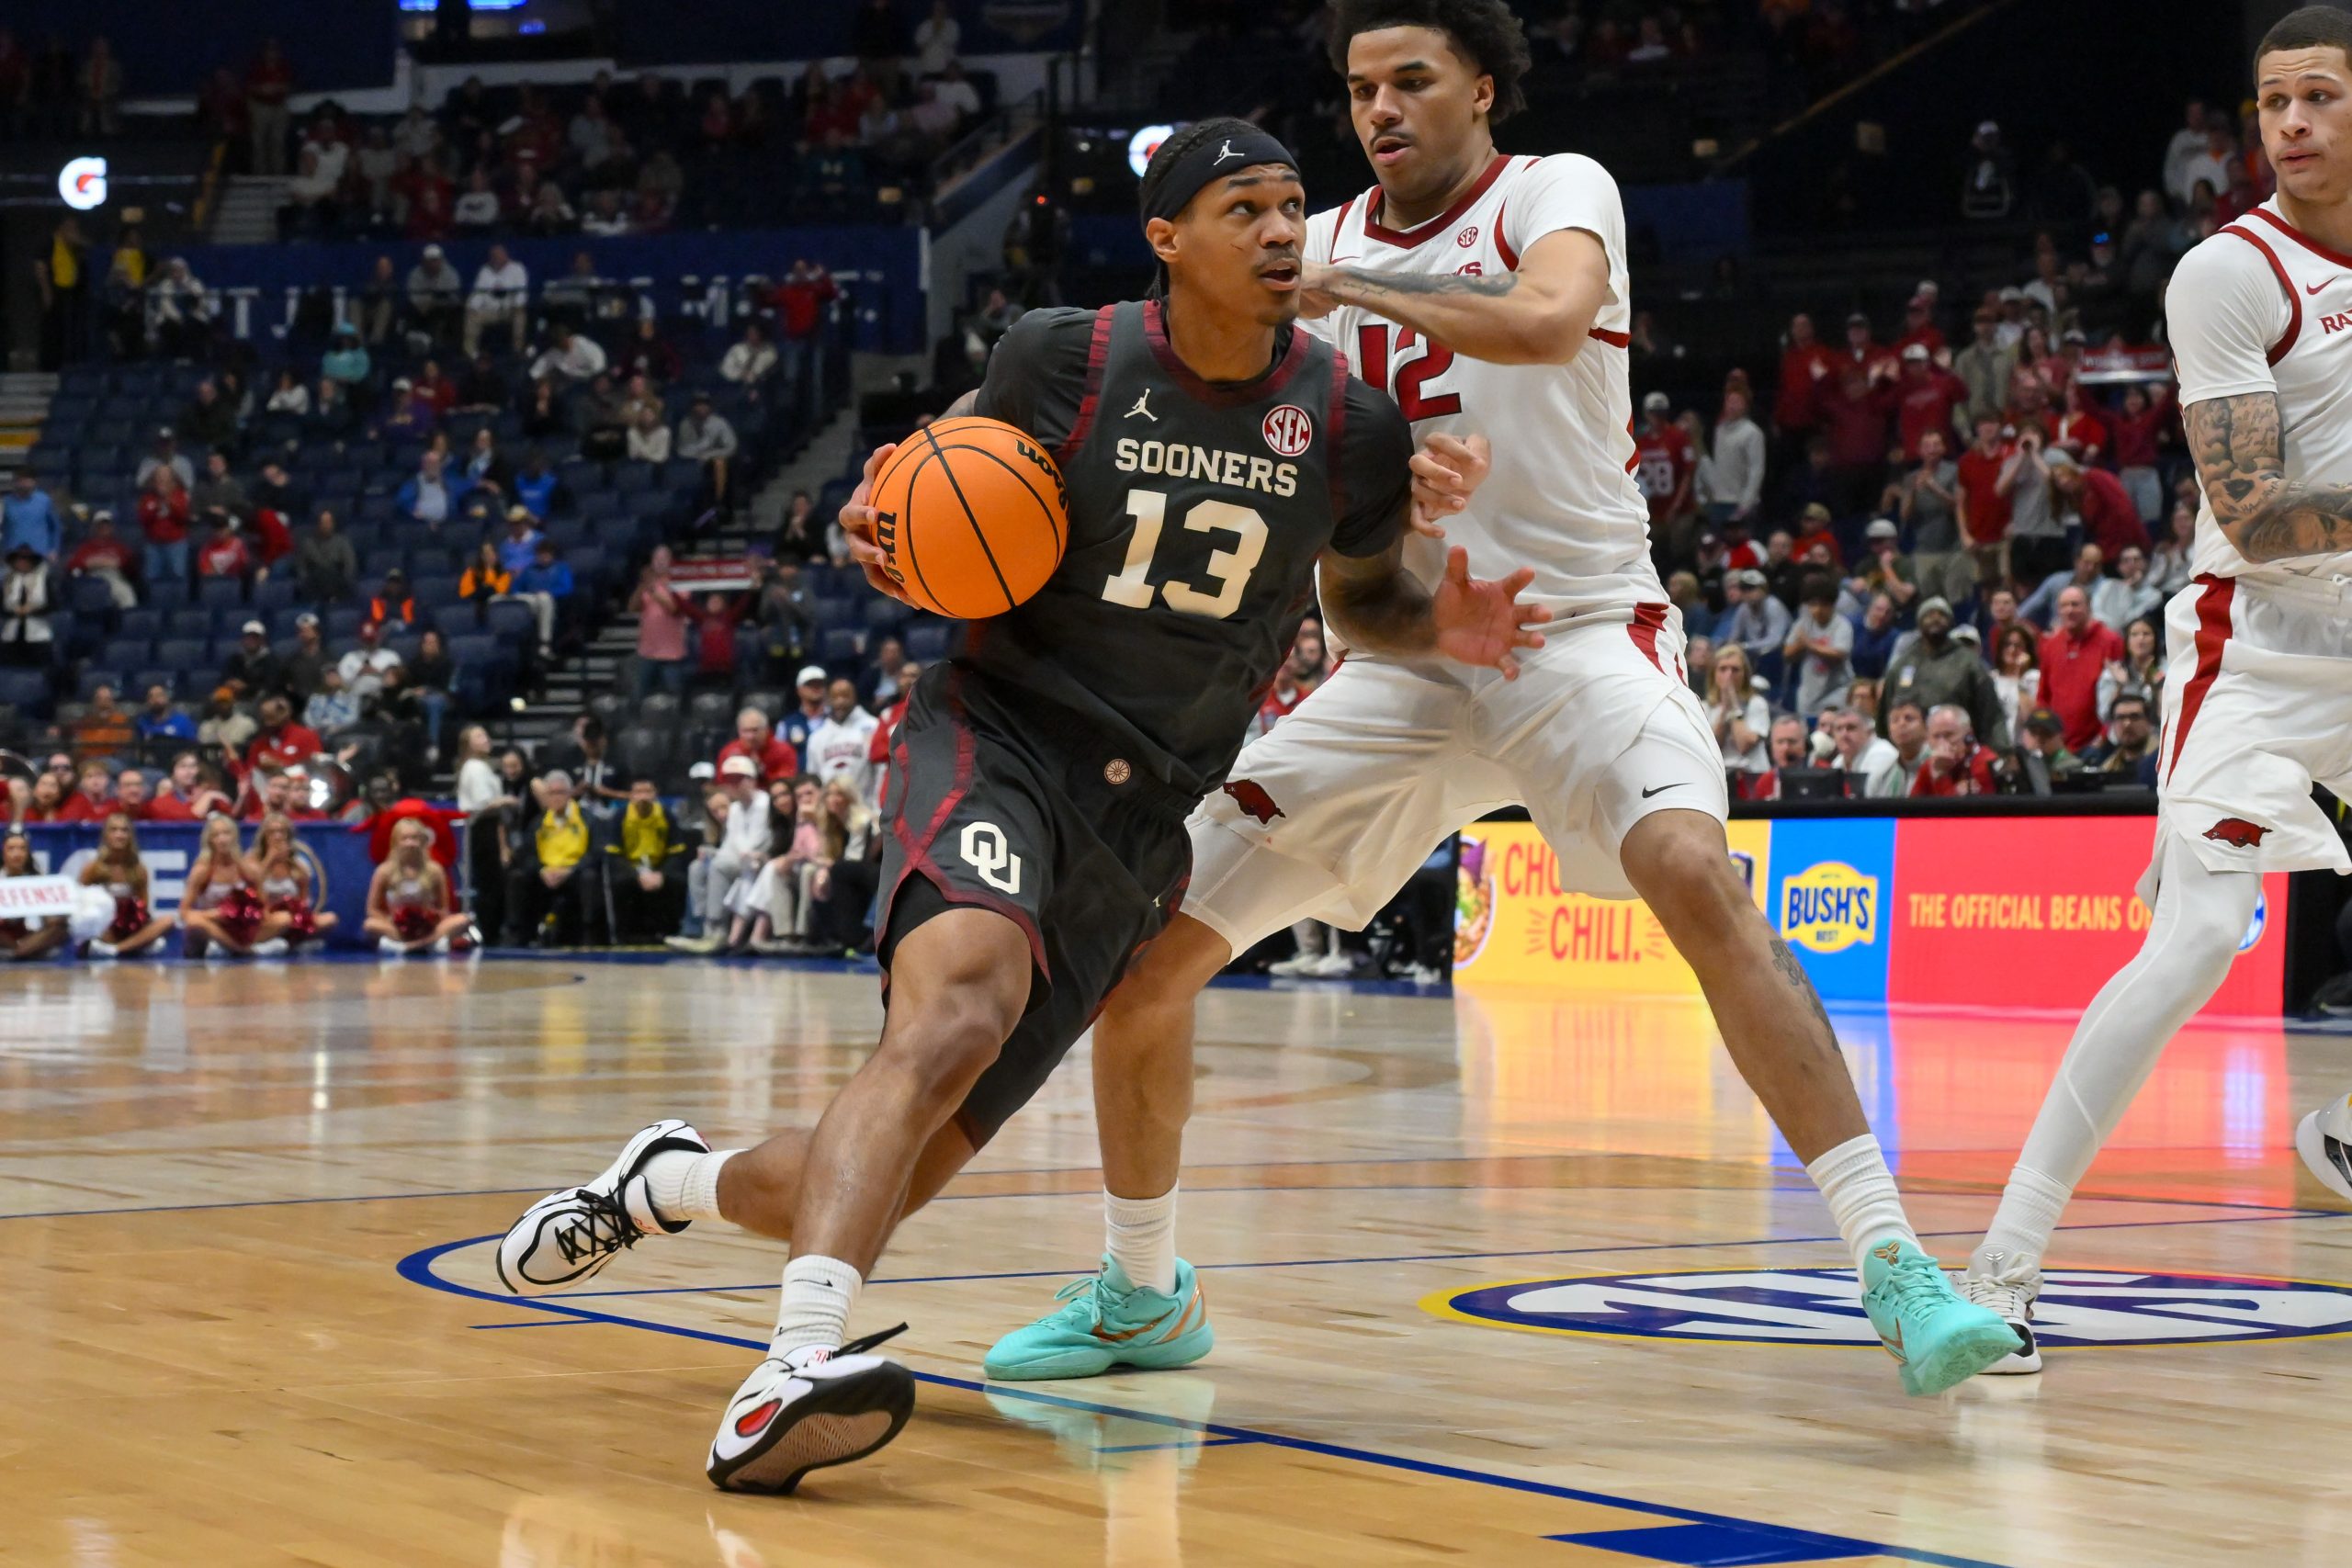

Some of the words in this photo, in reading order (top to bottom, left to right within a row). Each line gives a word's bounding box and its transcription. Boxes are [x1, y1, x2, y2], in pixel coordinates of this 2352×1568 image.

[58, 156, 107, 209] G
[1458, 227, 1478, 248] SEC
[2319, 309, 2352, 334] RA
[1358, 323, 1463, 423] 12
[1266, 410, 1309, 454] SEC
[1114, 437, 1298, 497] SOONERS
[1101, 489, 1270, 620] 13
[959, 821, 1022, 895] OU
[0, 884, 70, 907] EFENSE
[1787, 886, 1871, 931] BUSH'S
[1908, 894, 1946, 927] THE
[1951, 895, 2044, 930] OFFICIAL
[2049, 896, 2122, 931] BEANS
[1550, 907, 1641, 963] CHILI.
